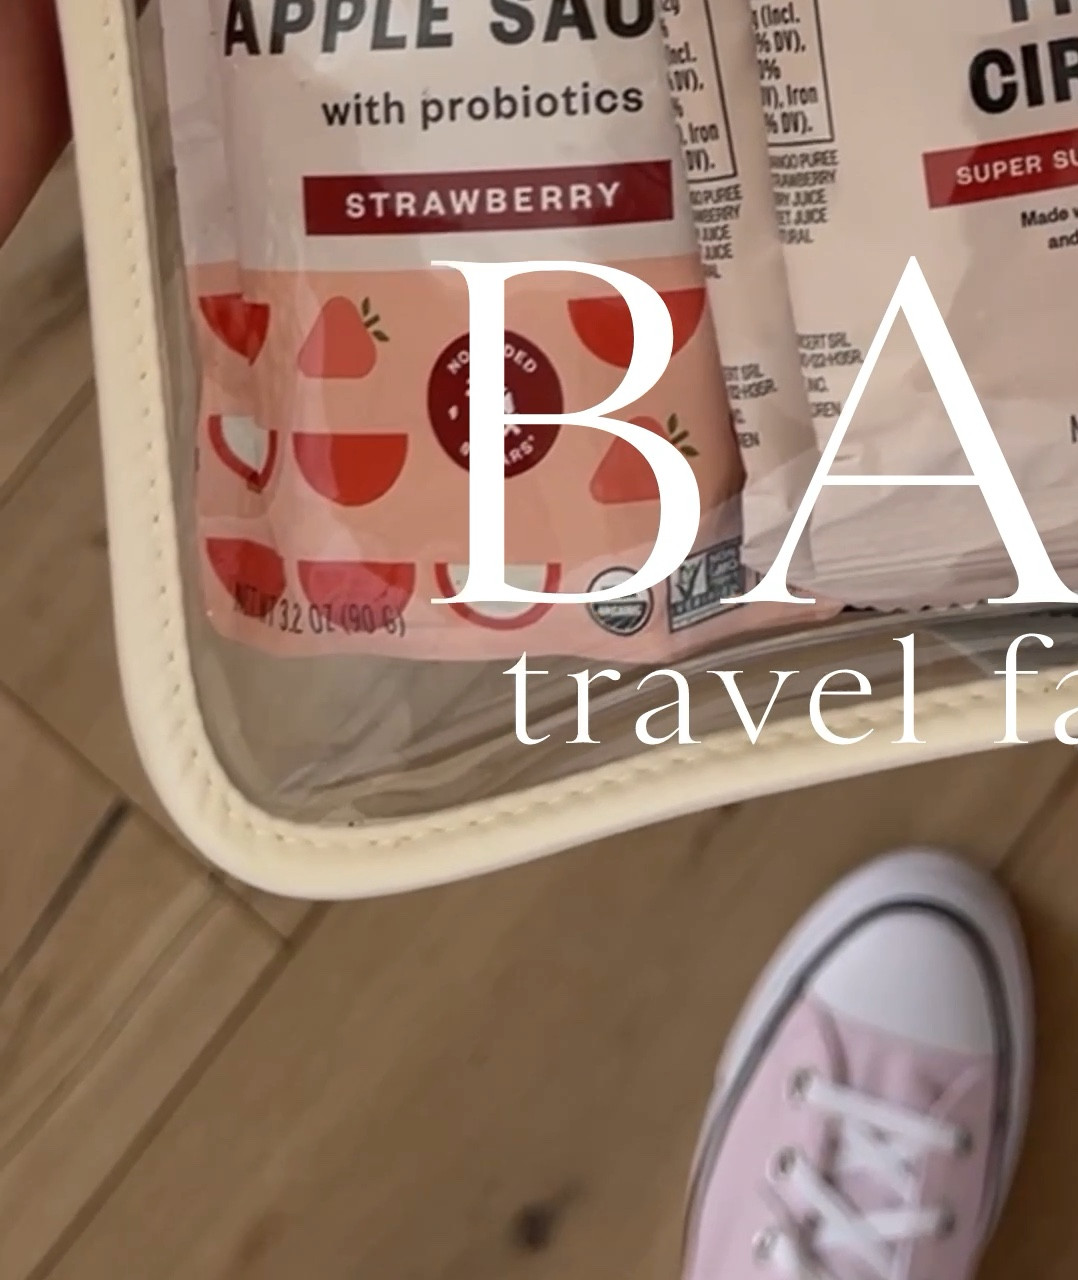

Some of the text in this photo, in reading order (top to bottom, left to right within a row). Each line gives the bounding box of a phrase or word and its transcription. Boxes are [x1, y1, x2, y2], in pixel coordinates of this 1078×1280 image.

[321, 81, 645, 132] with probiotics
[955, 155, 1043, 187] SUPER
[345, 180, 623, 220] STRAWBERRY
[1020, 207, 1070, 230] Made
